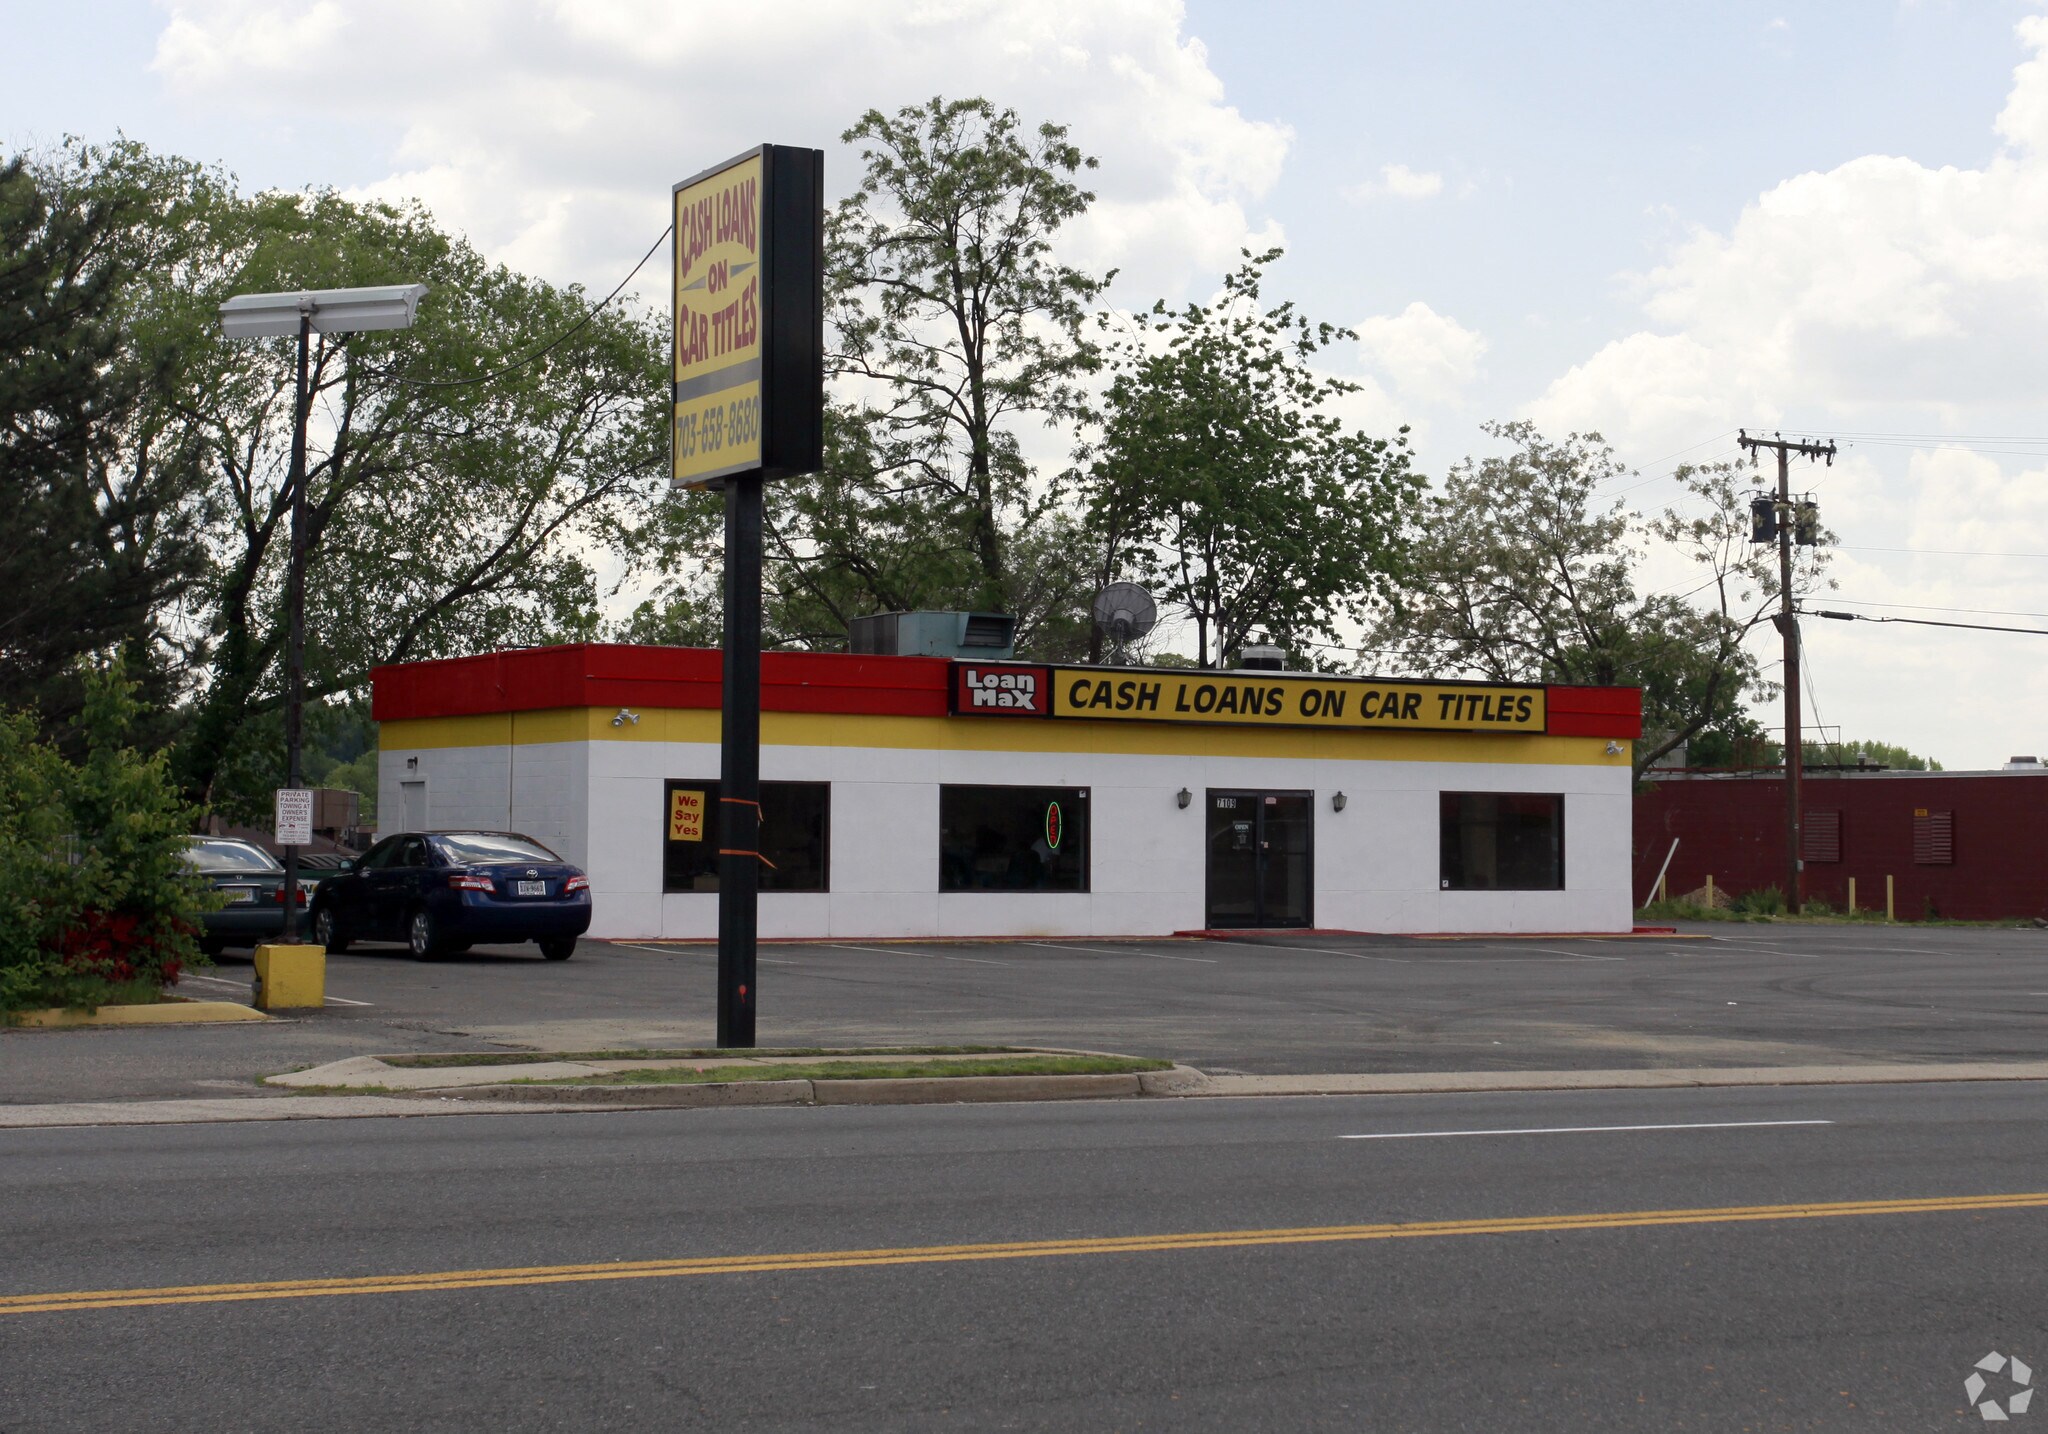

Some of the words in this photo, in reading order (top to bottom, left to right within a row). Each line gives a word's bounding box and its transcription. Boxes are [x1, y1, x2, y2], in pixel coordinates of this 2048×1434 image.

[681, 196, 713, 279] CASH
[716, 176, 756, 254] LOANS
[708, 259, 728, 294] ON
[680, 304, 709, 367] CAR
[712, 275, 757, 356] TITLES
[675, 395, 759, 461] 703-658-8680
[967, 670, 1035, 692] Loan
[1068, 679, 1162, 711] CASH
[1174, 684, 1285, 716] LOANS
[1299, 689, 1347, 718] ON
[1360, 691, 1423, 720] CAR
[1437, 693, 1533, 723] TITLES
[675, 810, 700, 823] Say
[678, 796, 698, 807] We
[675, 824, 698, 835] Yes
